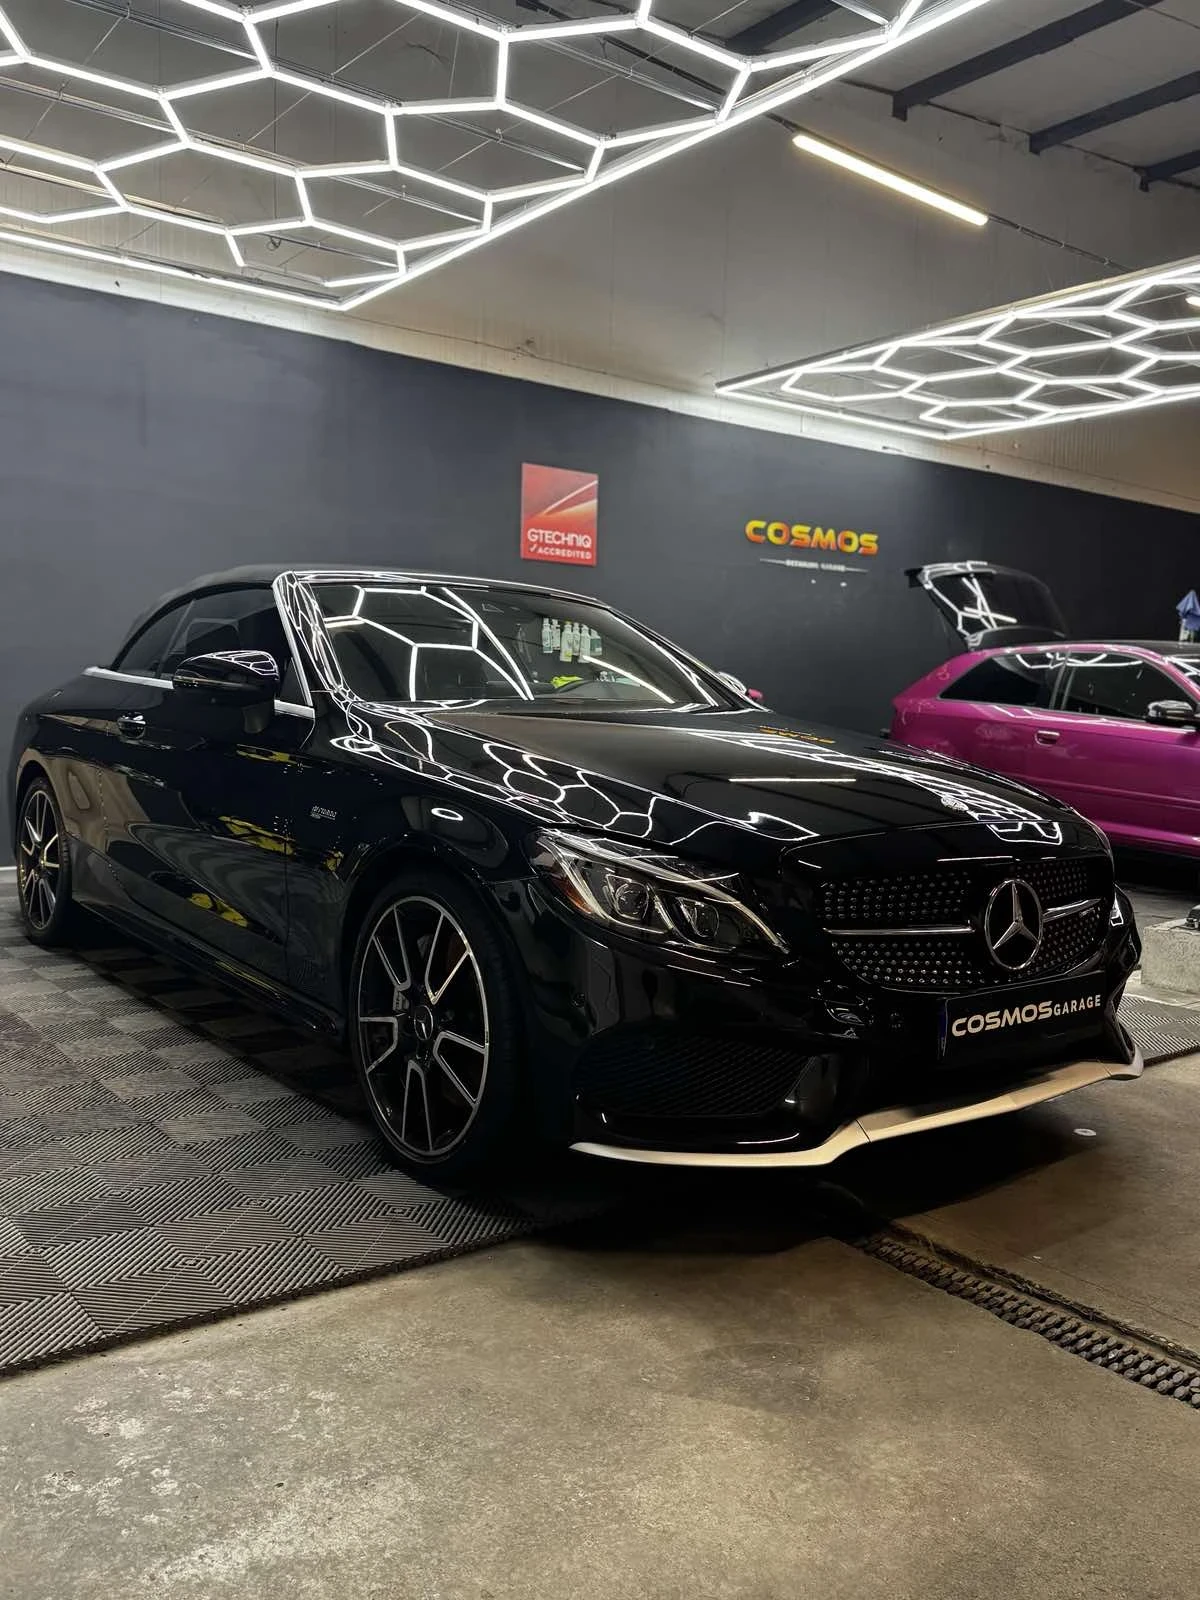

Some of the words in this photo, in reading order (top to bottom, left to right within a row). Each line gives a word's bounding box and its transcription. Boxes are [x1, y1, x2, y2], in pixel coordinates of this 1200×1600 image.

[527, 528, 592, 548] GTECHNIQ
[745, 520, 878, 555] COSMOS
[537, 546, 592, 560] ACCREDITED
[952, 1001, 1053, 1037] COSMOS
[1053, 994, 1101, 1016] GARAGE
